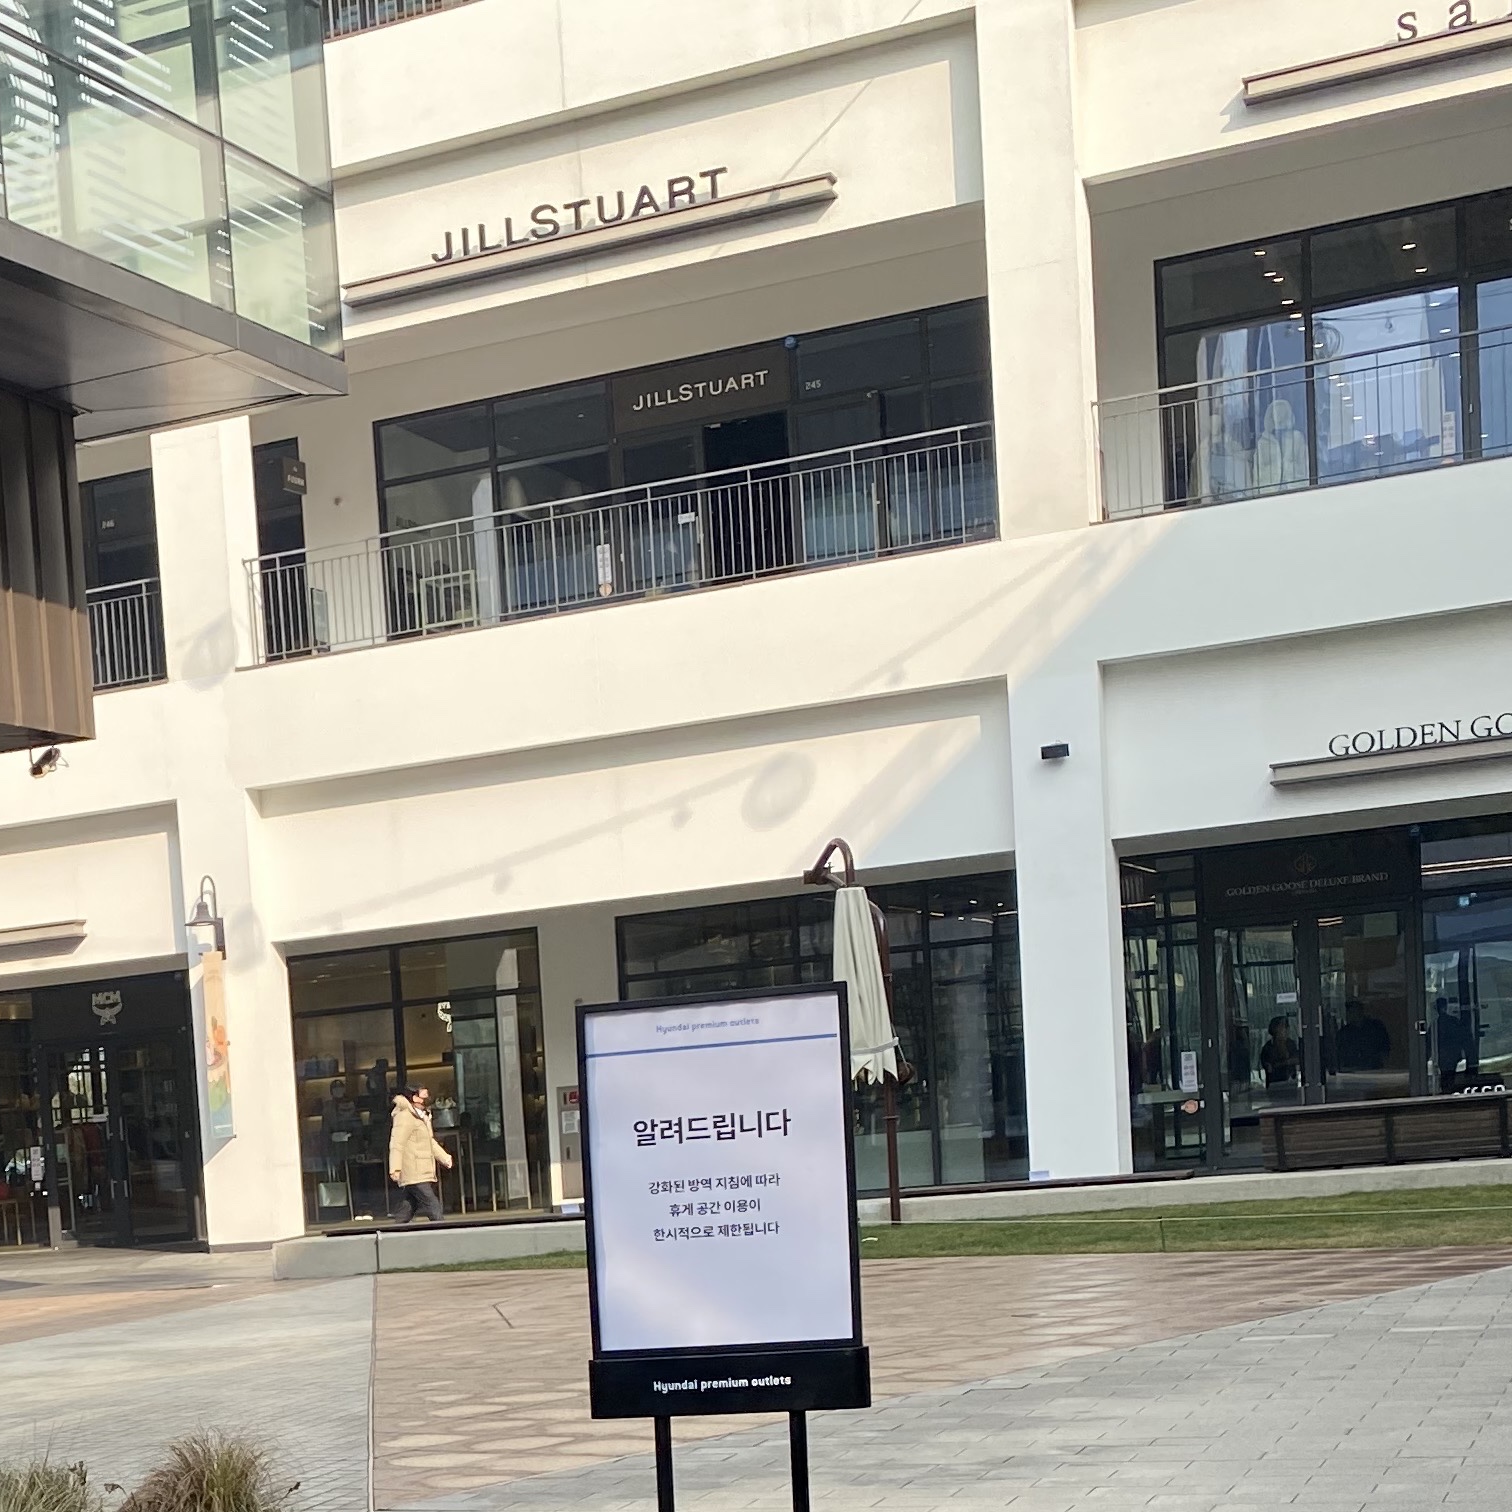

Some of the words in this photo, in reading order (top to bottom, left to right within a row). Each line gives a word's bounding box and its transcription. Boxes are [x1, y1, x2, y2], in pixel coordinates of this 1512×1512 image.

[1397, 0, 1512, 42] sa
[431, 167, 728, 263] JILLSTUART
[632, 369, 769, 412] JILLSTUART
[1328, 720, 1462, 757] GOLDEN
[656, 1023, 690, 1034] Hyundai
[691, 1020, 728, 1032] premium
[729, 1017, 760, 1027] outlets
[633, 1109, 792, 1147] 알려드립니다
[648, 1180, 685, 1195] 강화된
[688, 1178, 712, 1191] 방역
[715, 1175, 753, 1190] 지침에
[755, 1173, 781, 1187] 따라
[669, 1203, 694, 1218] 휴게
[696, 1201, 721, 1216] 공간
[724, 1198, 761, 1213] 이용이
[653, 1226, 715, 1242] 한시적으로
[717, 1221, 780, 1238] 제한됩니다
[653, 1380, 698, 1394] Hyundai
[700, 1377, 749, 1392] premium
[751, 1374, 792, 1387] outlets
